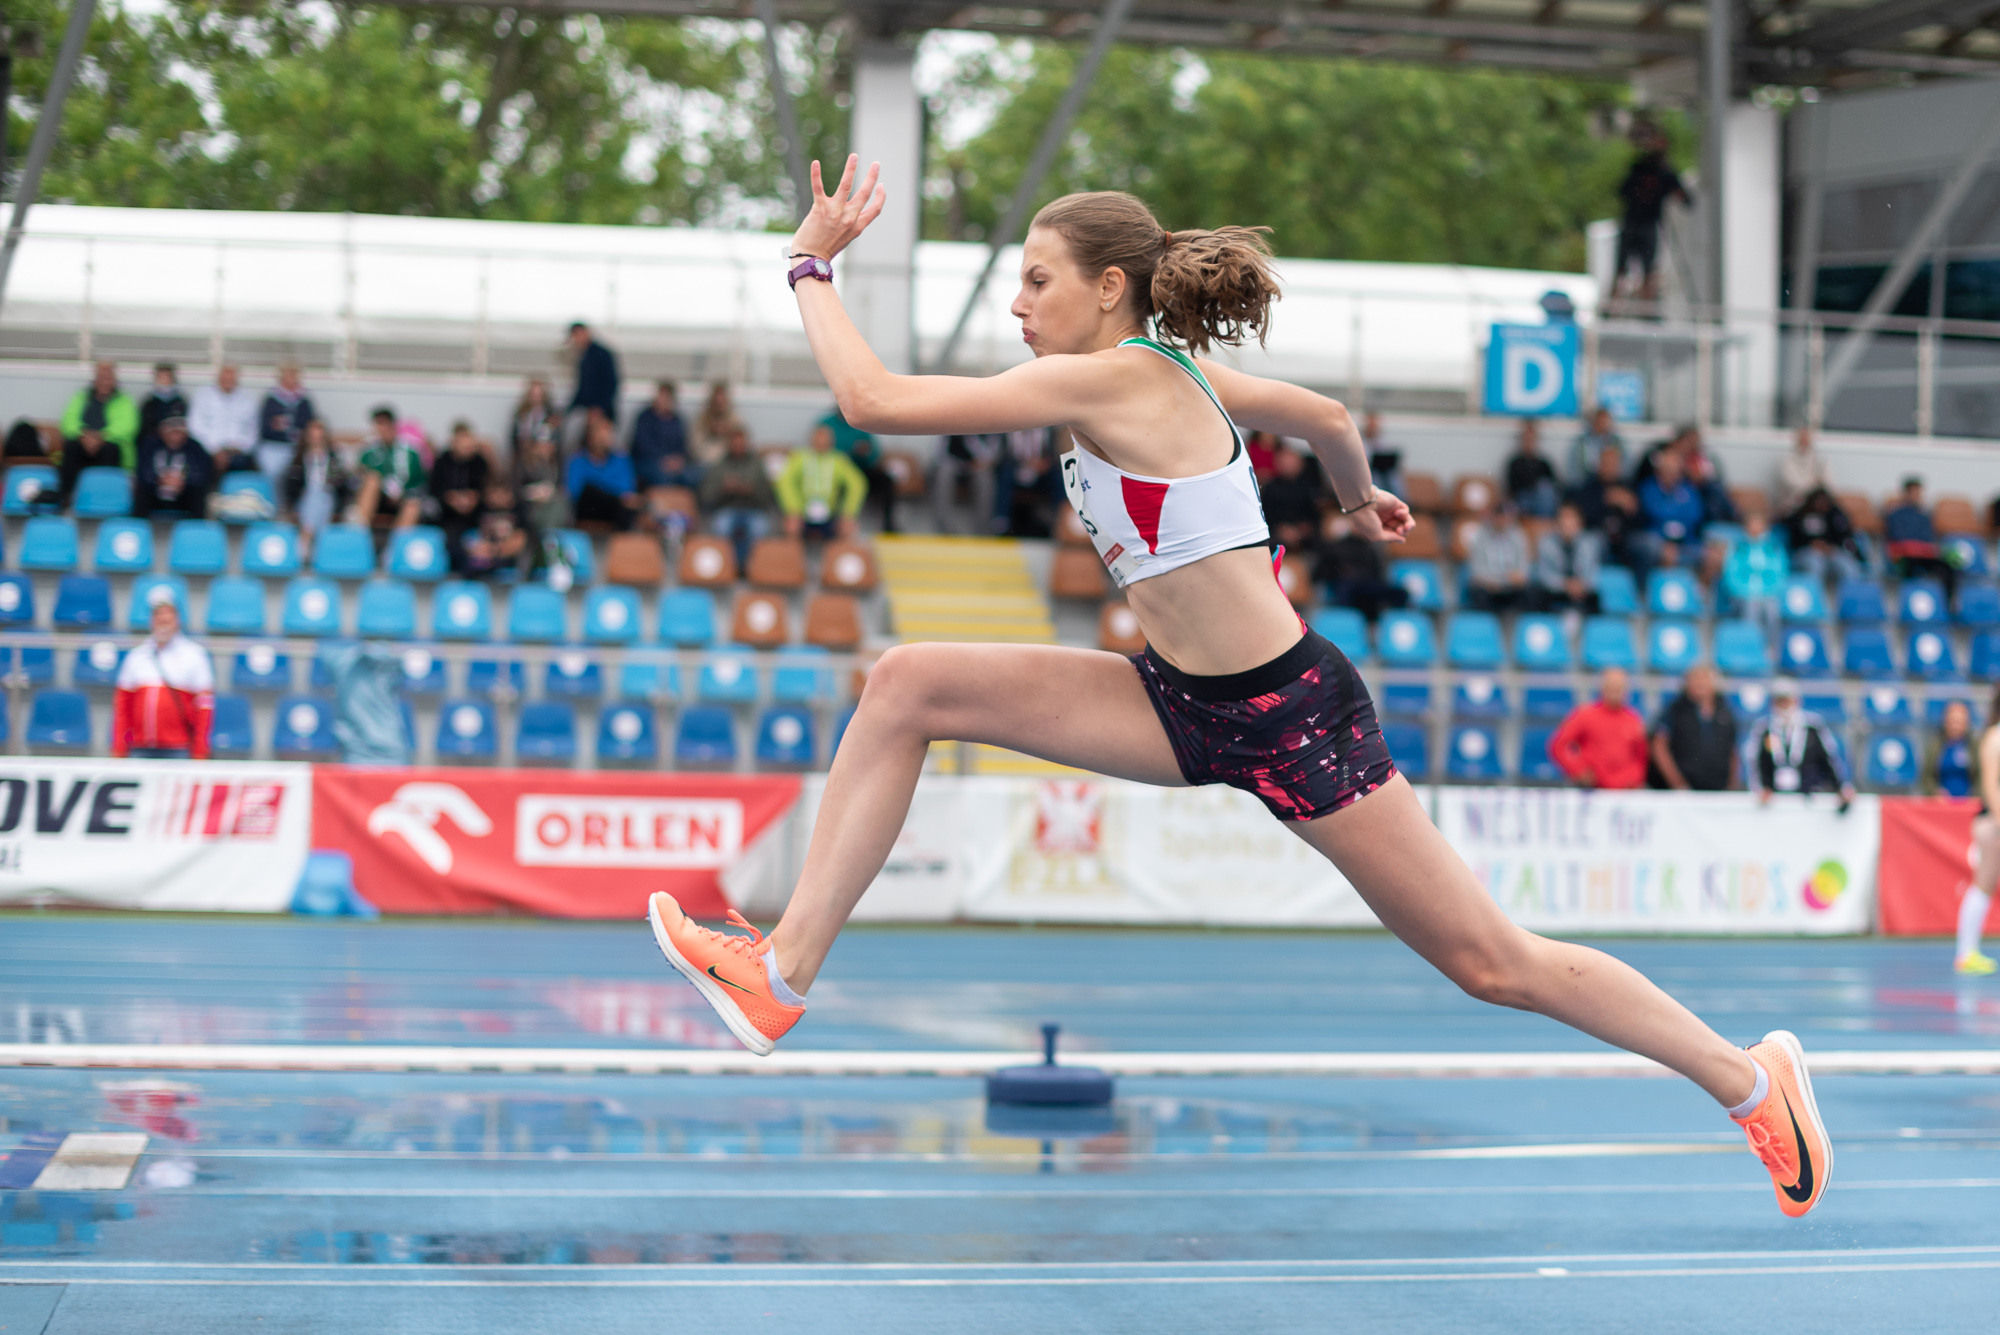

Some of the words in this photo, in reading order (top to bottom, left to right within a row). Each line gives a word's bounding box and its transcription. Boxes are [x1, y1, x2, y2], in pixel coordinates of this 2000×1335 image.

[1502, 343, 1564, 410] D
[536, 811, 723, 851] ORLEN
[1699, 860, 1789, 916] KIDS
